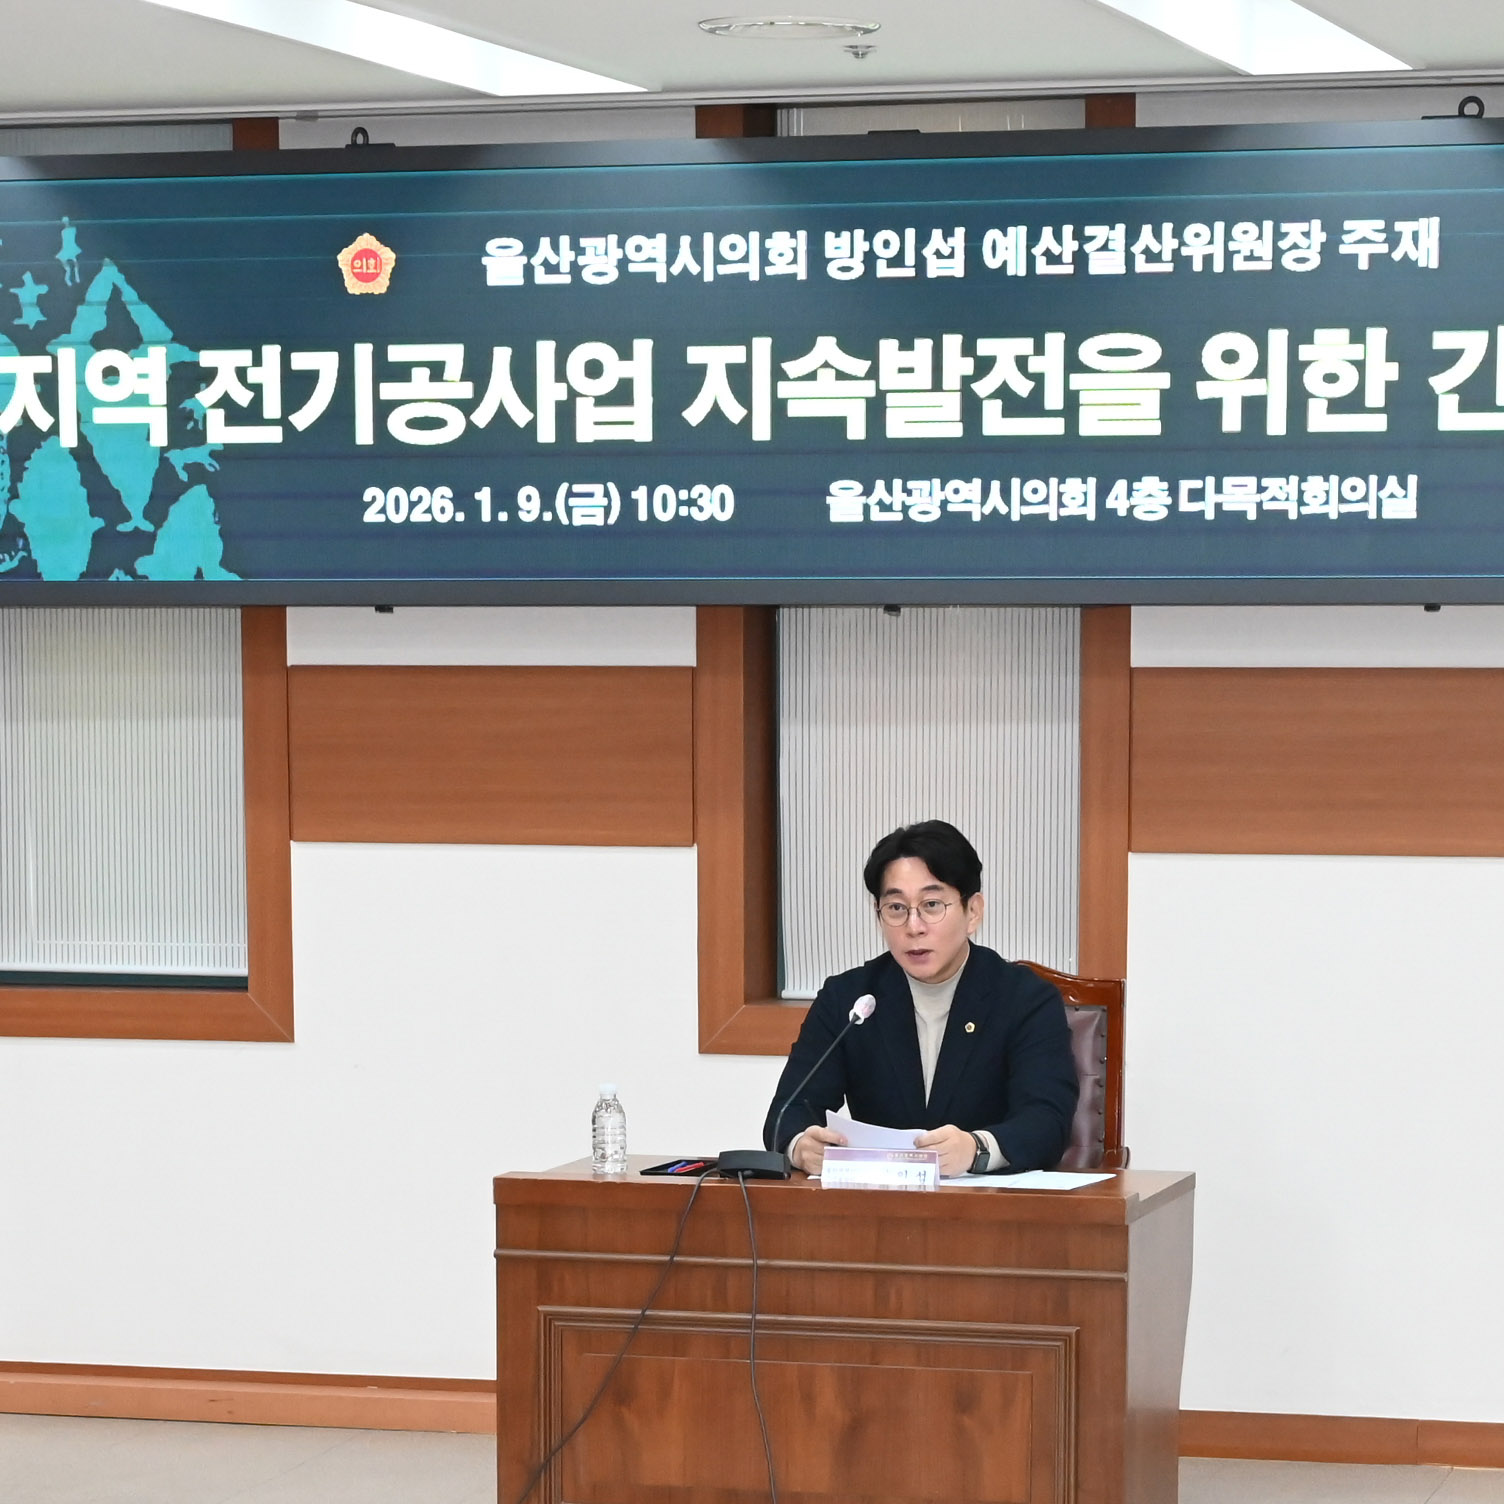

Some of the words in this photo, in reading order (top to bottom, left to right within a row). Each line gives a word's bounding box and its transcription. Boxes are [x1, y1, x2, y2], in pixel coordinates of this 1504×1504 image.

[353, 257, 380, 273] 의회
[481, 229, 808, 287] 울산광역시의회
[824, 227, 966, 281] 방인섭
[982, 218, 1327, 277] 예산결산위원장
[1338, 216, 1441, 271] 주재
[194, 338, 654, 446] 전기공사업
[681, 332, 1171, 442] 지속발전을
[1195, 327, 1400, 436] 위한
[631, 483, 735, 522] 10:30
[825, 476, 1097, 523] 울산광역시의회
[1105, 475, 1173, 522] 4층
[1178, 474, 1418, 521] 다목적회의실
